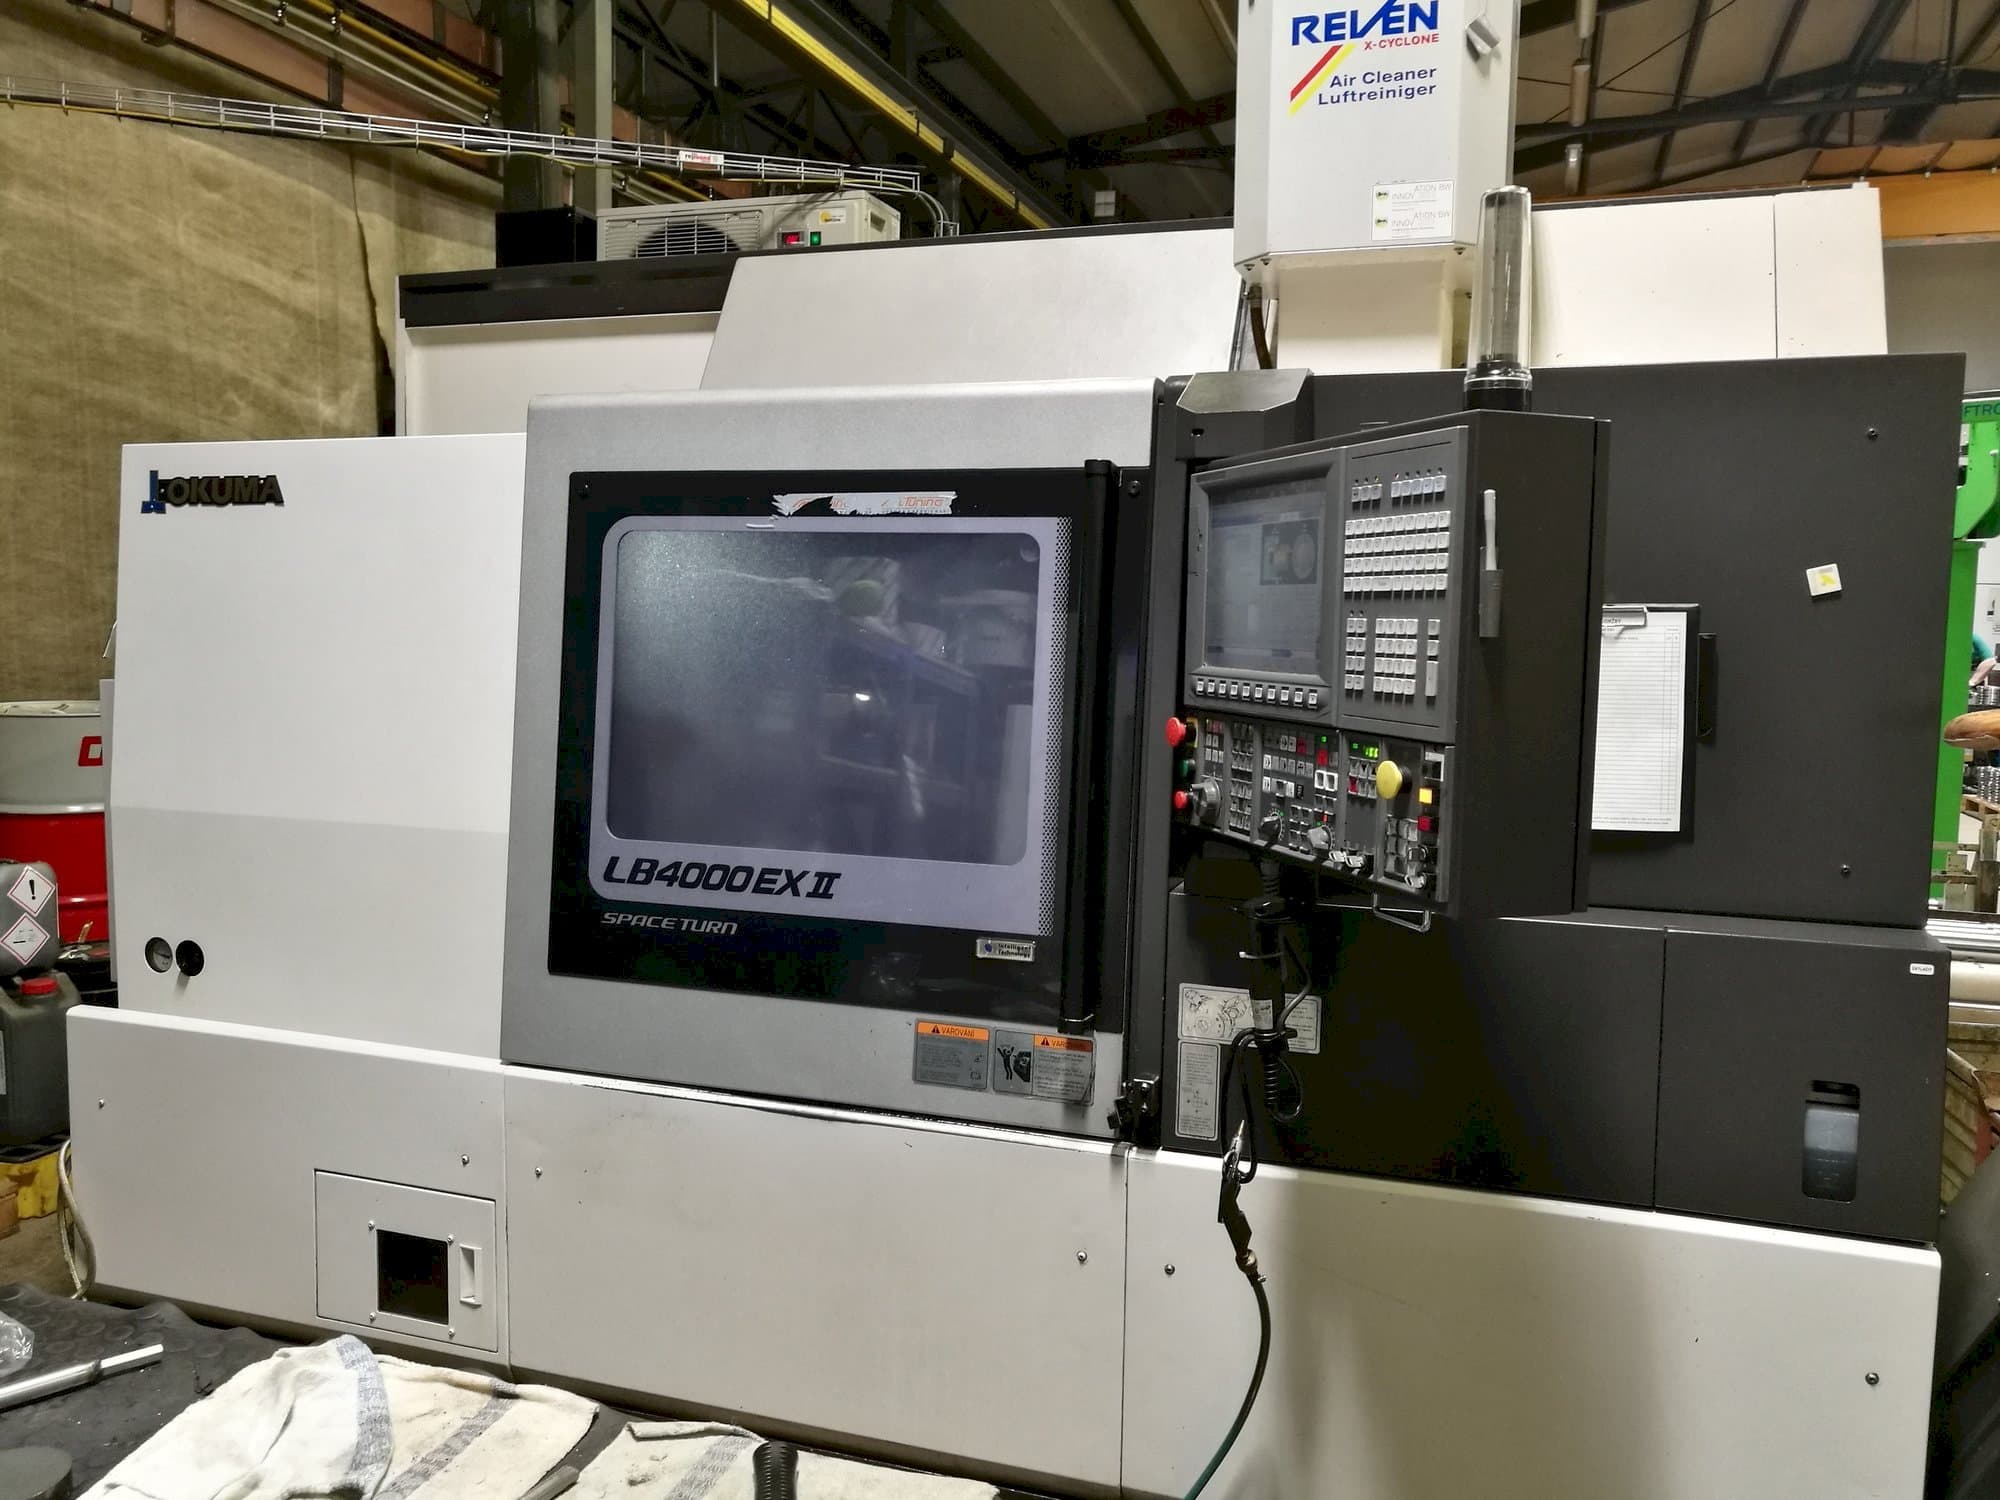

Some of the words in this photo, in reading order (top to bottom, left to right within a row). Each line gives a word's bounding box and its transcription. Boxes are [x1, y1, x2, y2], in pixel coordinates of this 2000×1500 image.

[1292, 0, 1439, 46] REVEN
[1364, 33, 1440, 50] X-CYCLONE
[1330, 74, 1357, 88] Air
[1362, 68, 1437, 85] Cleaner
[1318, 84, 1437, 106] Luftreiniger
[166, 475, 284, 507] OKUMA
